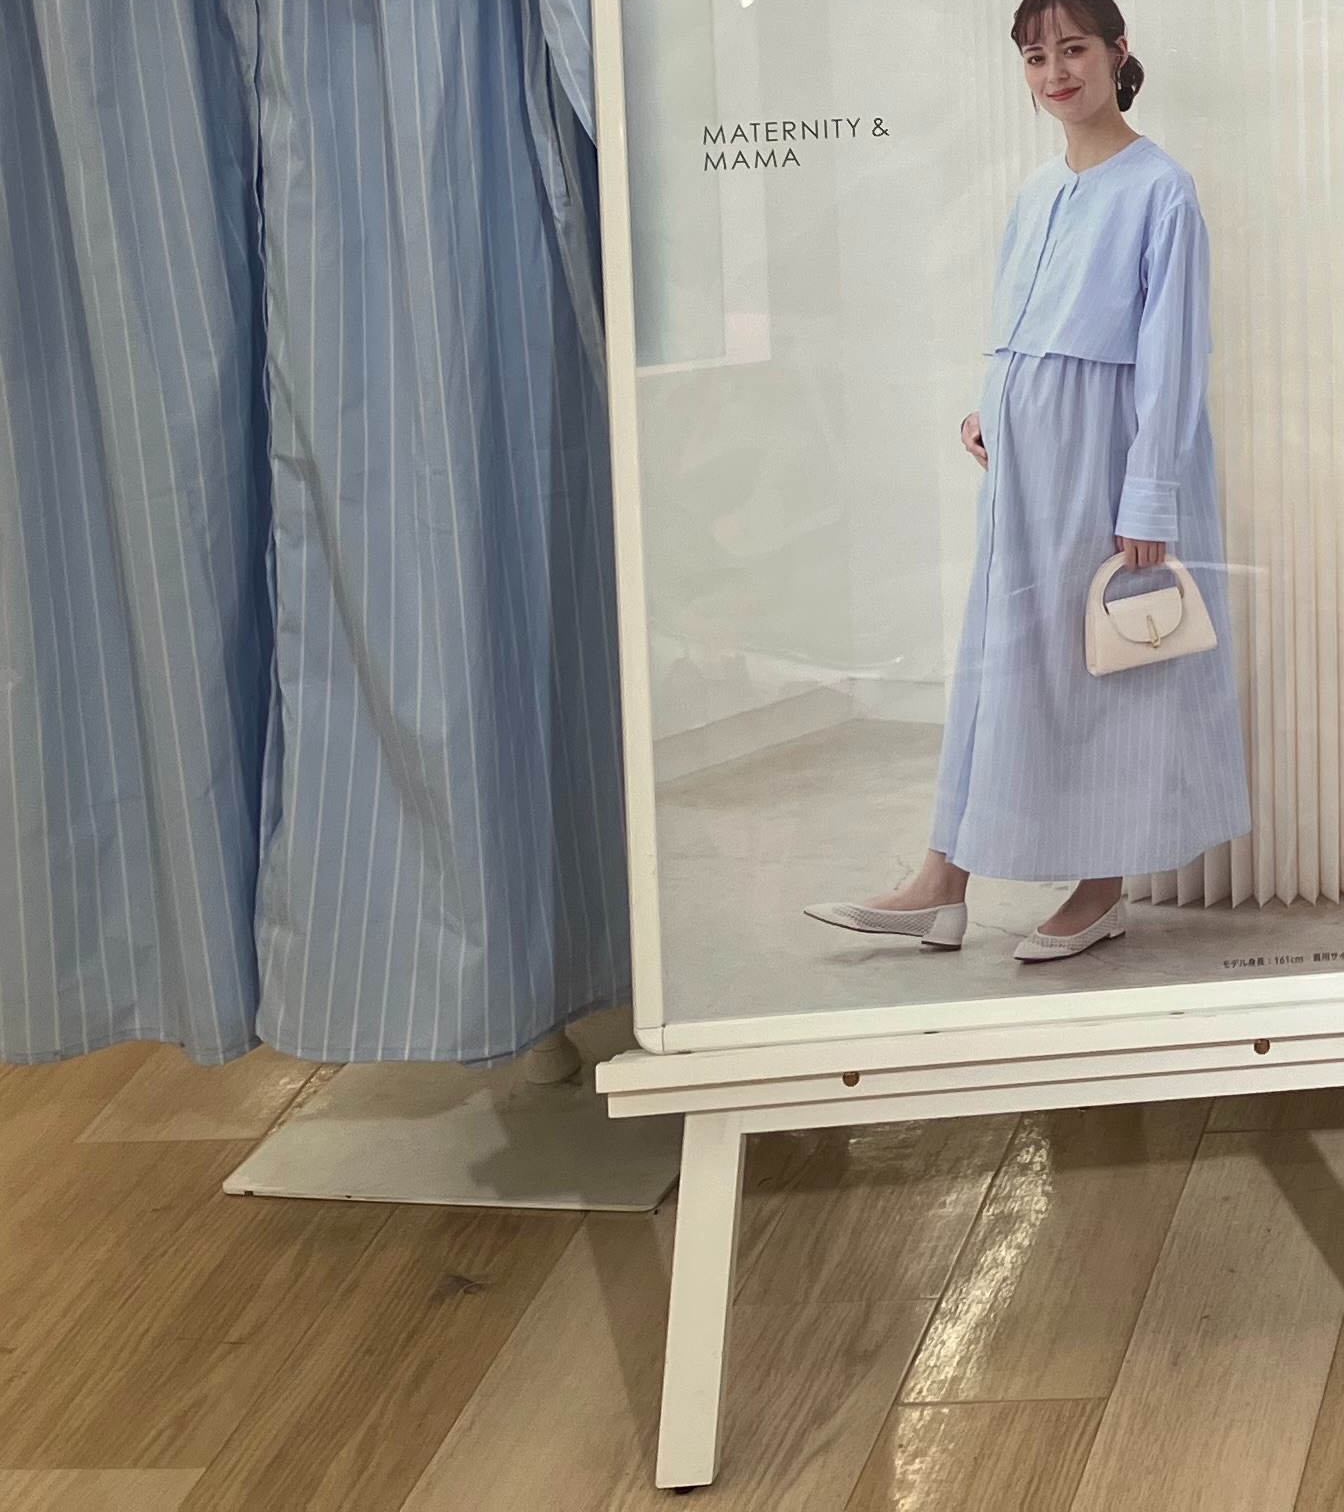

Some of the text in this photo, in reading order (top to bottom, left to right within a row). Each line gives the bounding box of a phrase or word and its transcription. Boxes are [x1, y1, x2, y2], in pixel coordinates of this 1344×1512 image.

[702, 117, 890, 145] MATERNITY &
[703, 148, 801, 171] MAMA
